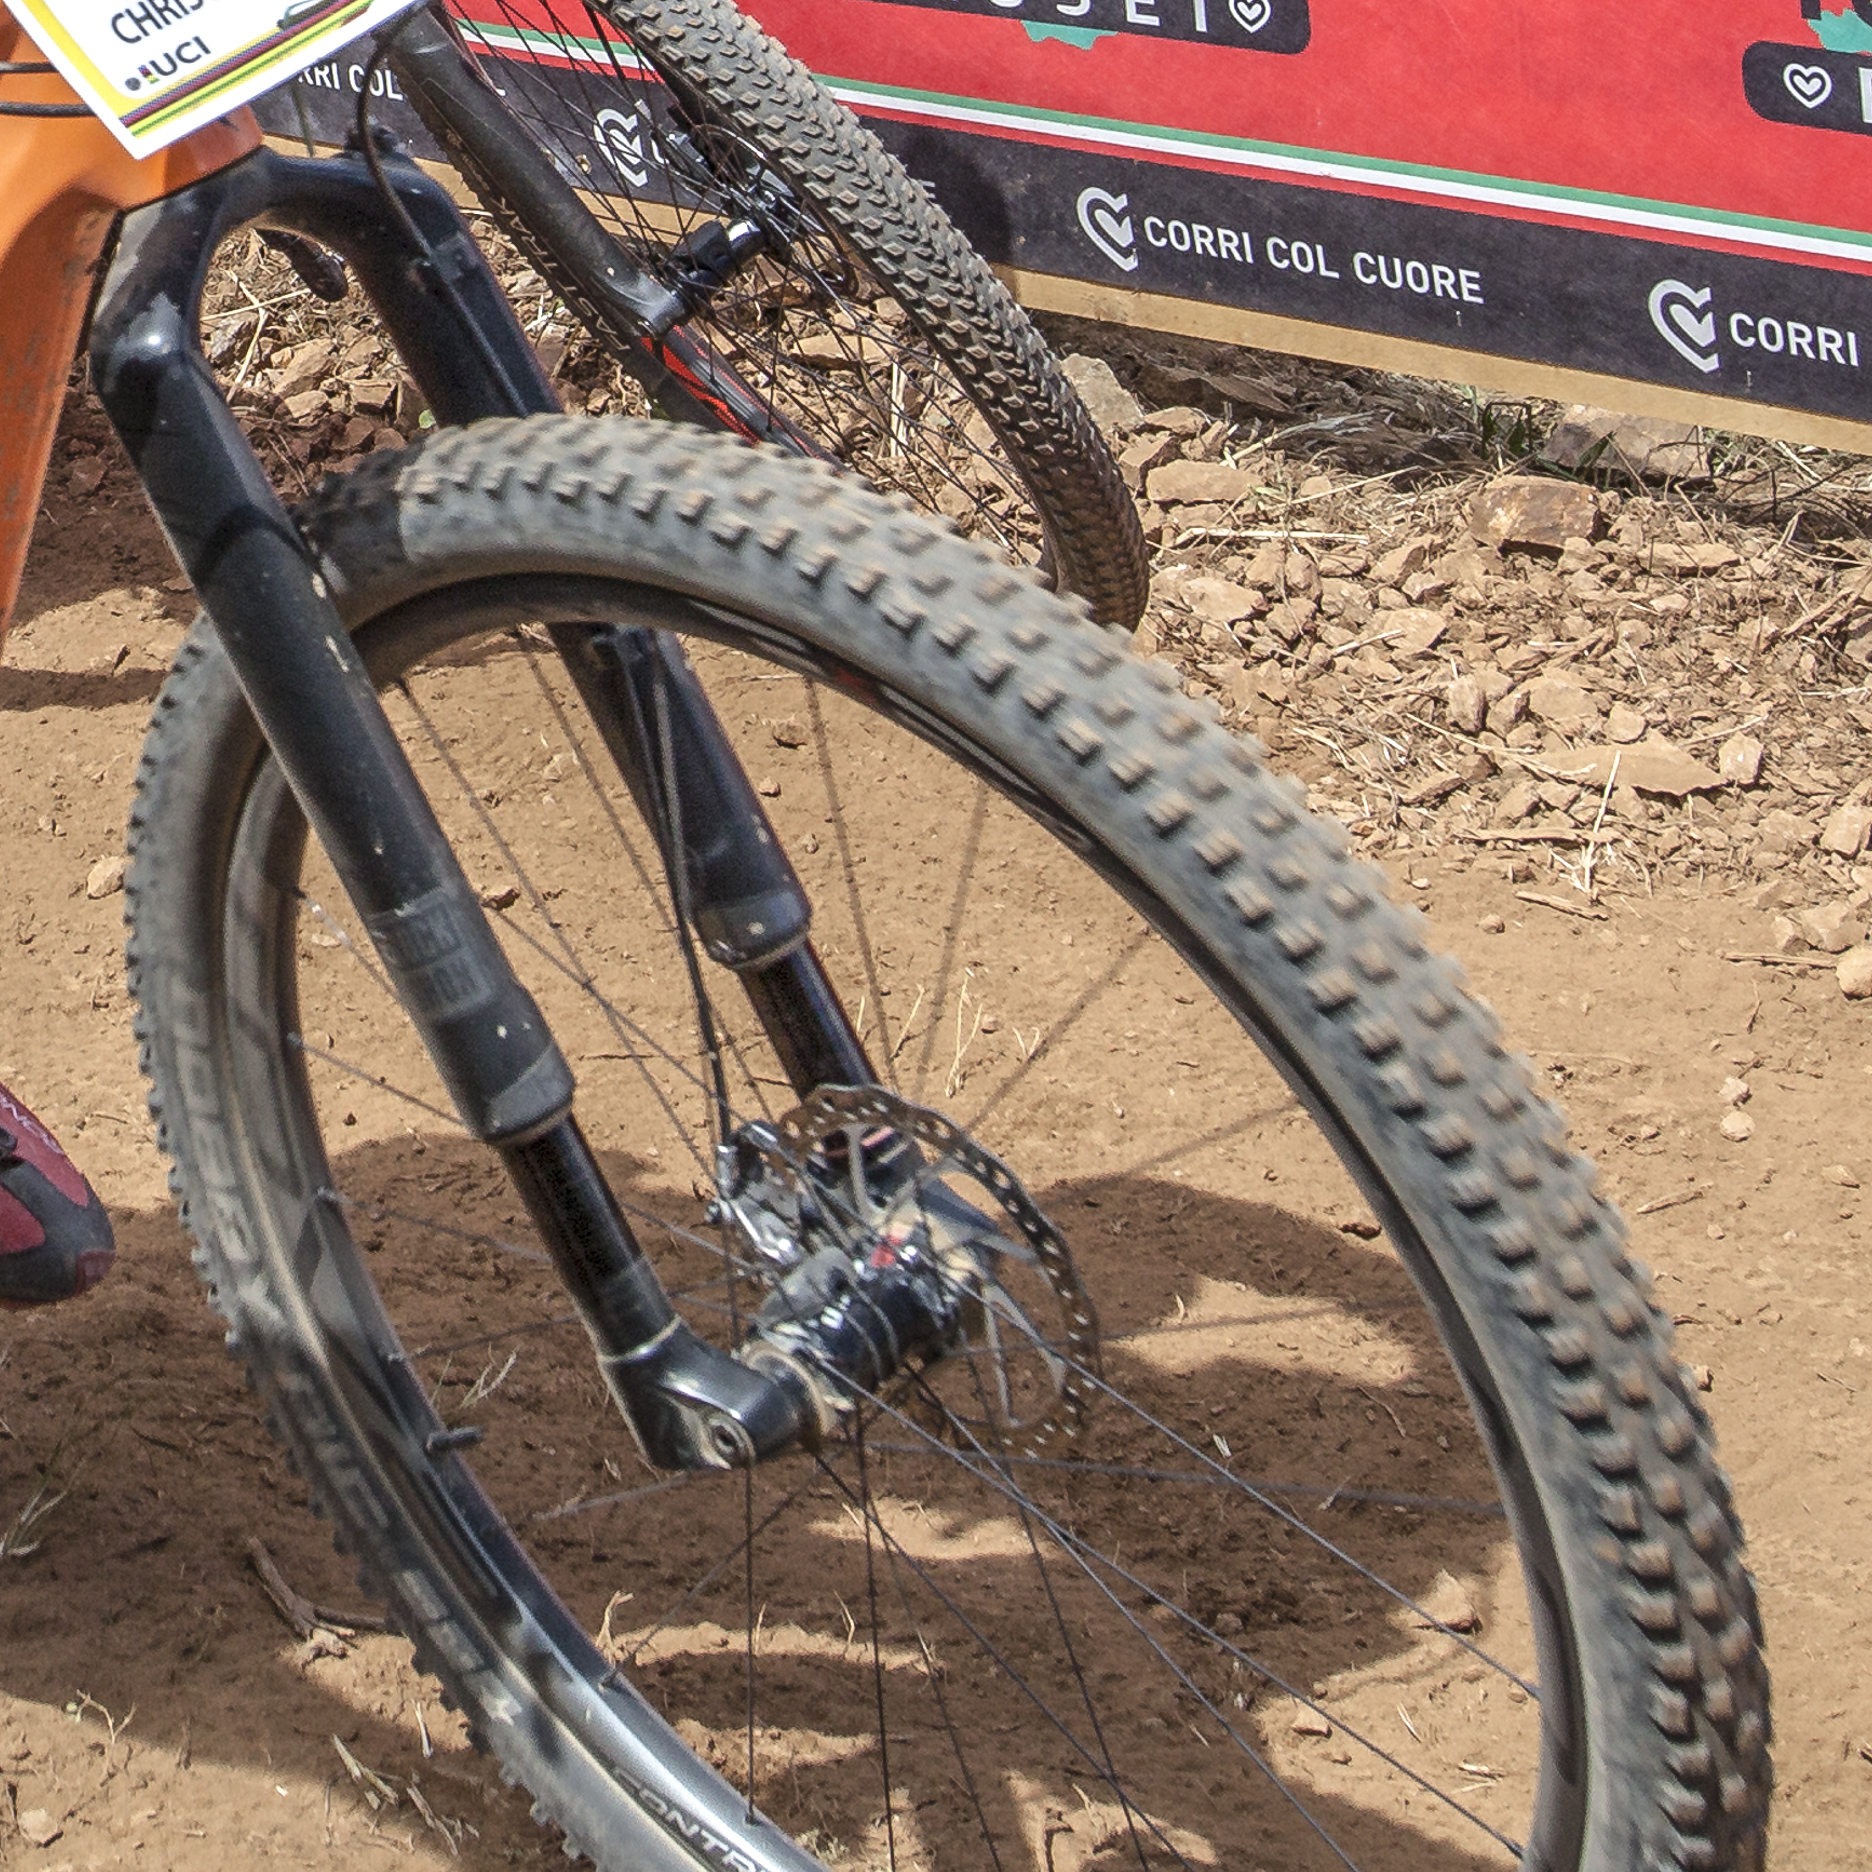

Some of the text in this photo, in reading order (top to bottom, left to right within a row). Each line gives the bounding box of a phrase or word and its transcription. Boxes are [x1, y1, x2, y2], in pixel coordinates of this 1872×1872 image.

[151, 34, 212, 79] UCI
[1143, 214, 1486, 306] CORRI COL CUORE
[1730, 311, 1859, 368] CORRI
